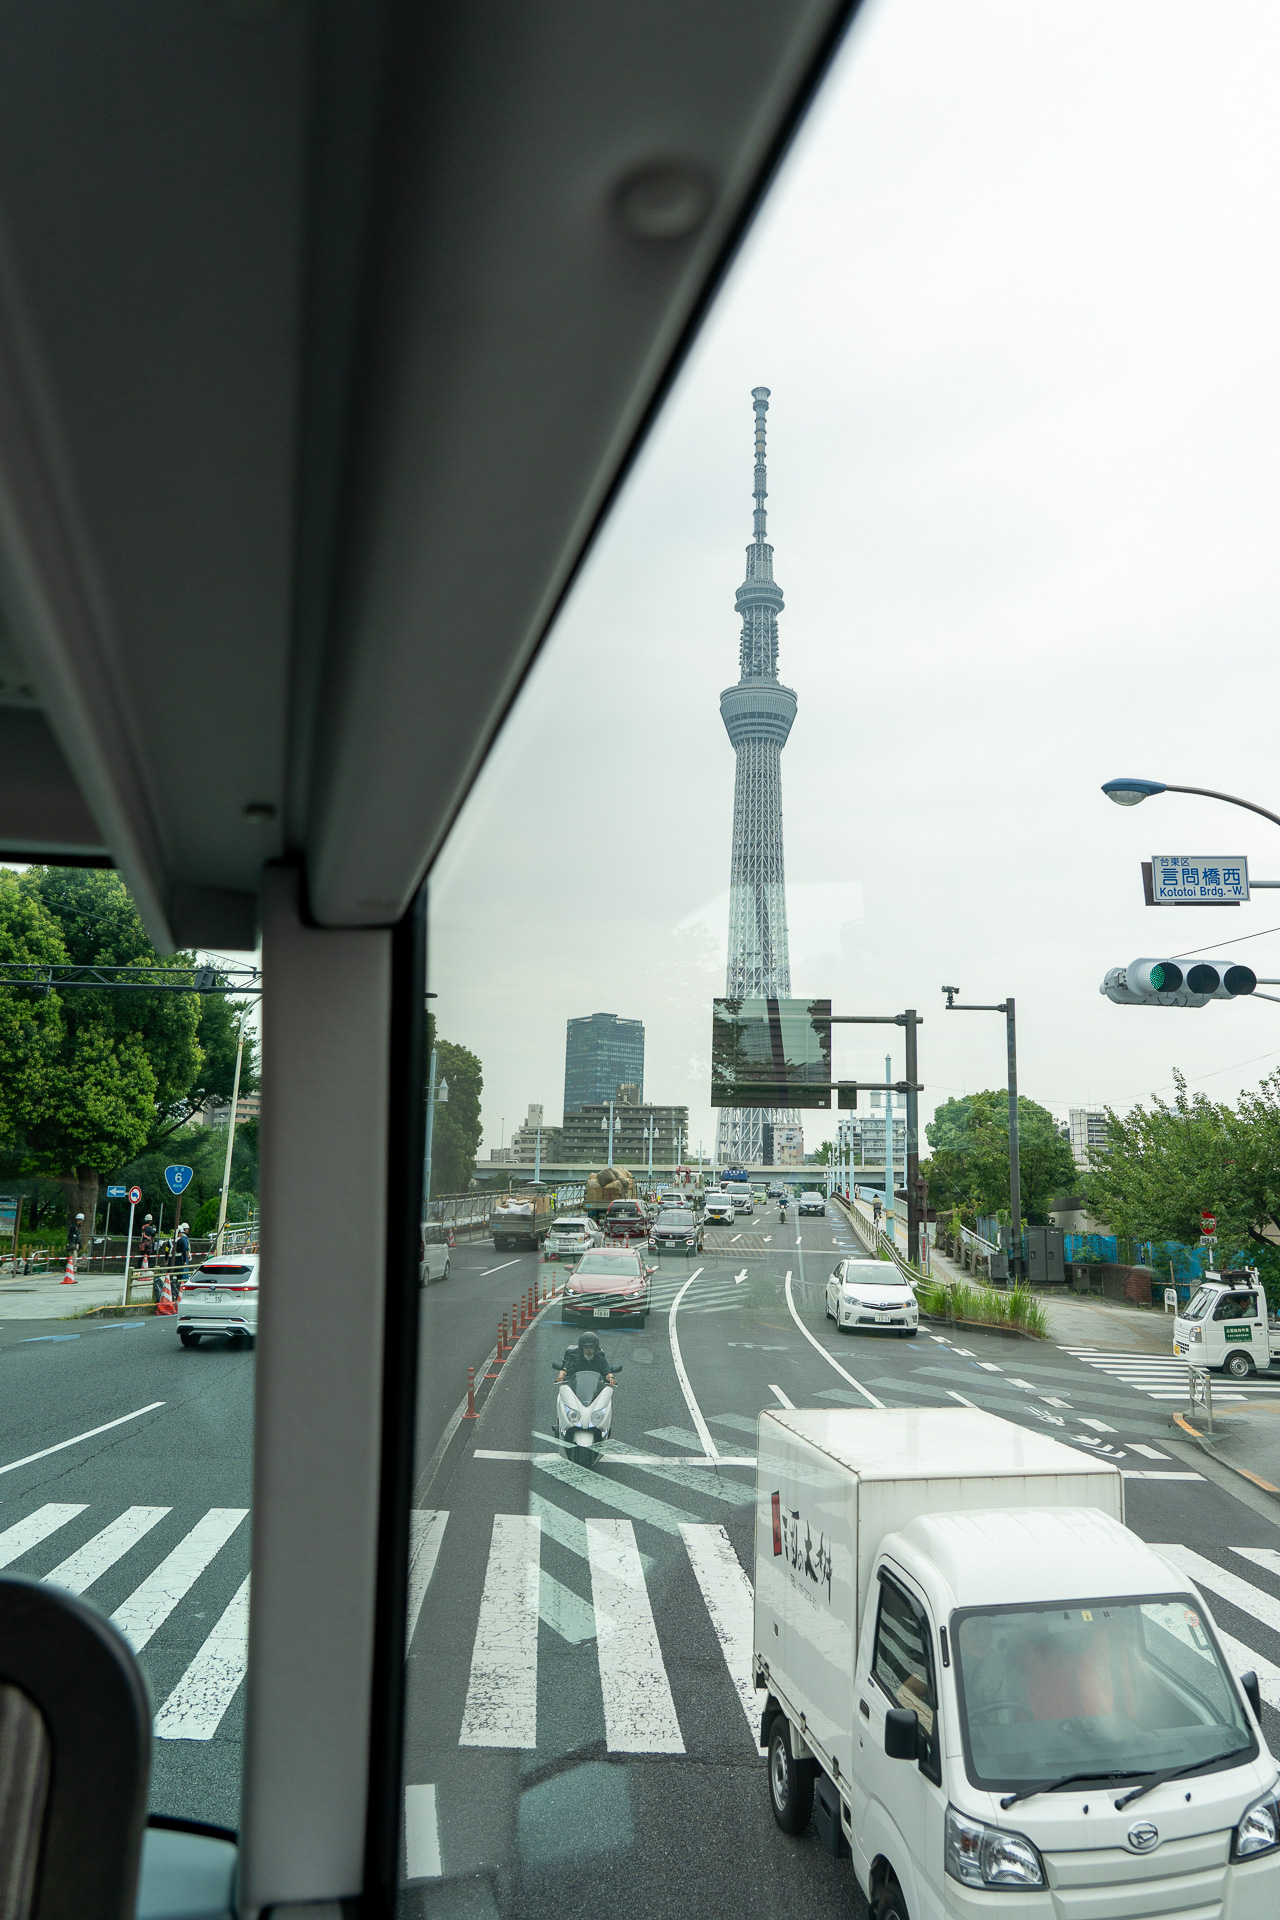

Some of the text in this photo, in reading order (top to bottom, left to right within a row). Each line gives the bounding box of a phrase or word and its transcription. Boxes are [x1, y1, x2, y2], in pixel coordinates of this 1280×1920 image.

[1160, 857, 1190, 867] 台東区
[1161, 867, 1241, 886] 言問橋西
[1159, 885, 1245, 897] Kototoi Brdg.-W.
[174, 1172, 183, 1183] 6
